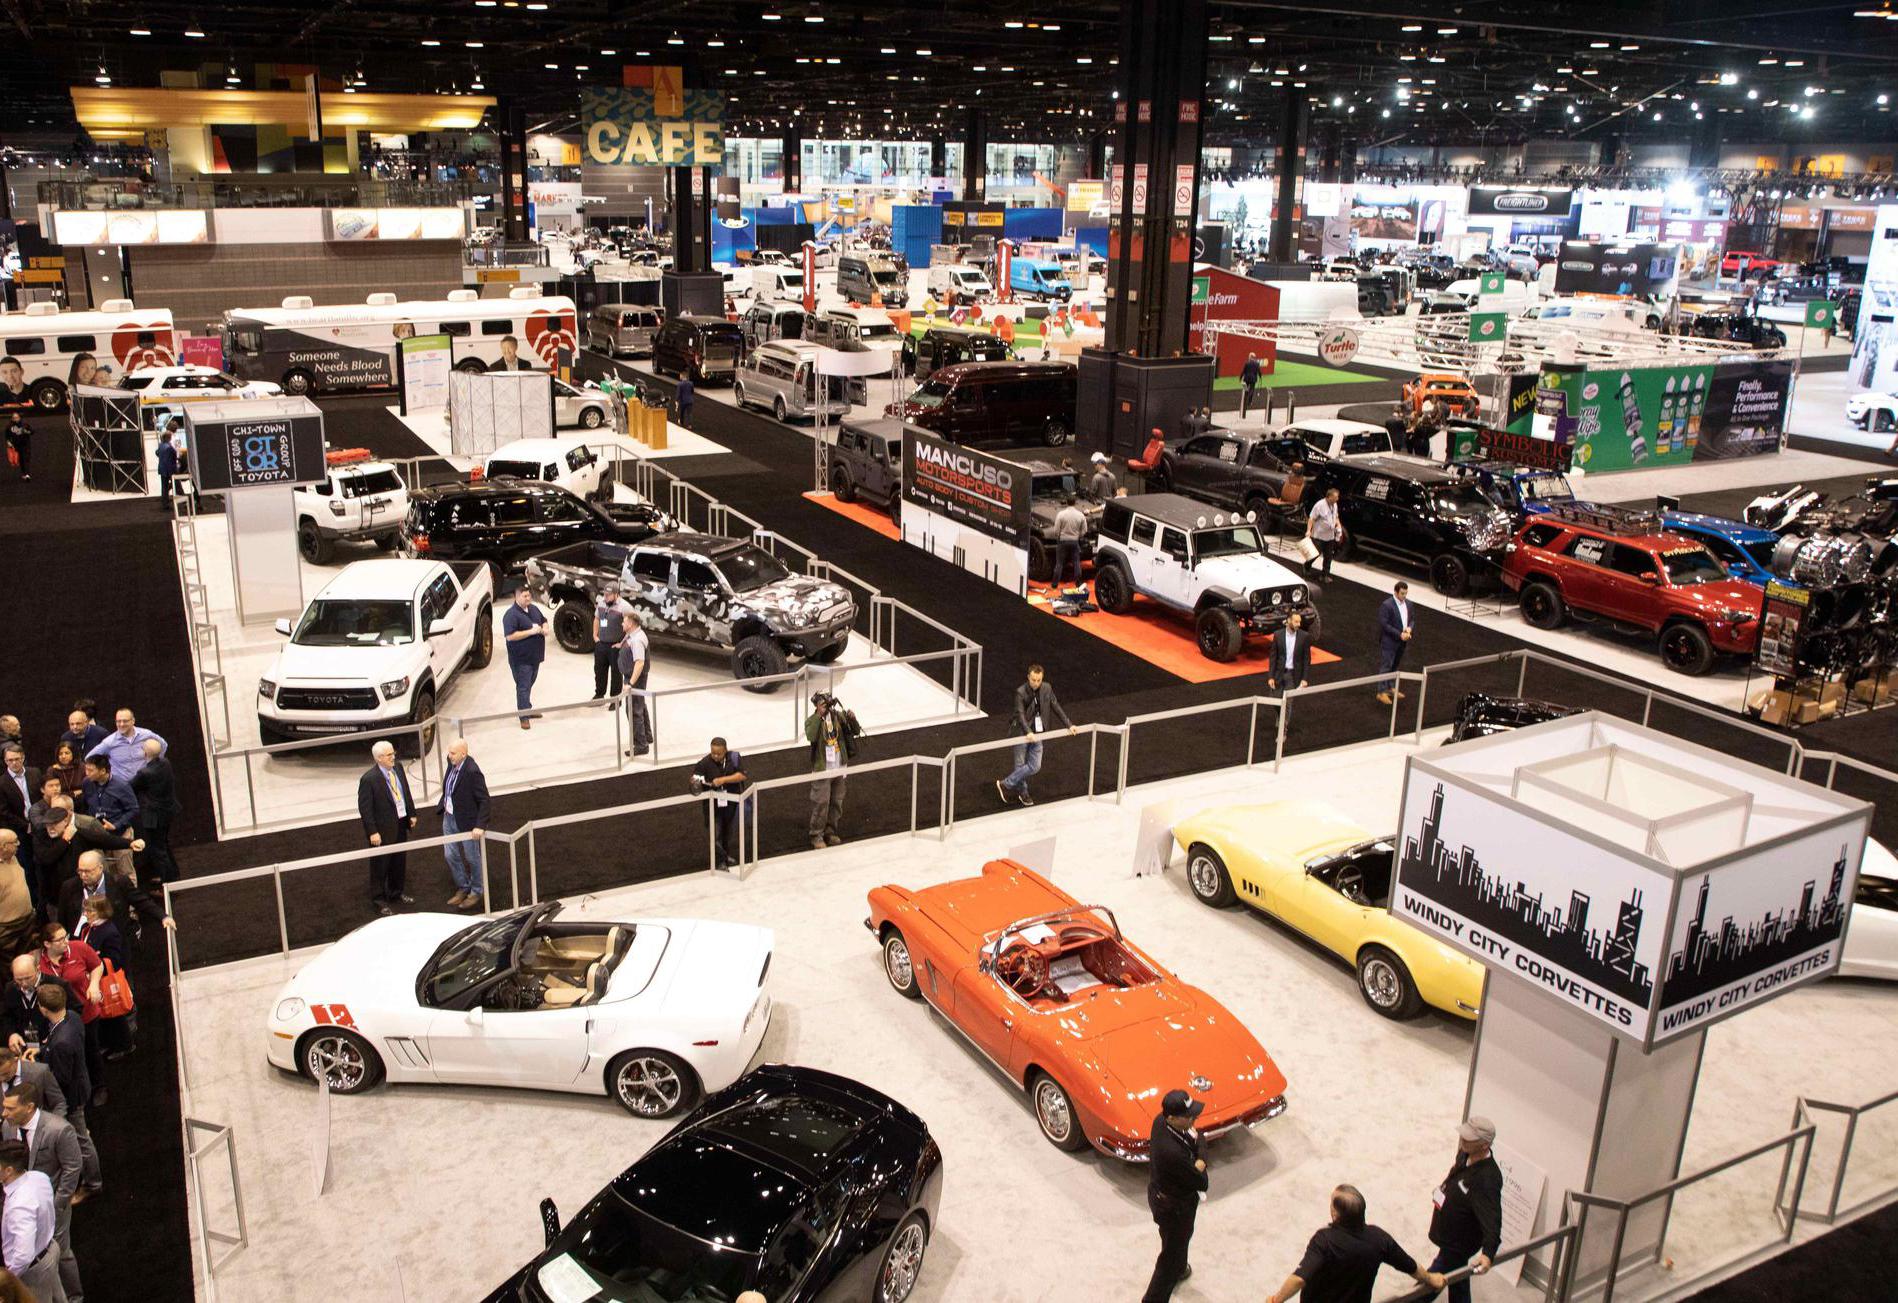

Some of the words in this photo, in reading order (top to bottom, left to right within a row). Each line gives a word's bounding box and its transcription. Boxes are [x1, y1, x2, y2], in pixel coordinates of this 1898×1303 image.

[587, 121, 721, 163] CAFE
[1176, 220, 1188, 228] T24
[1325, 338, 1355, 353] Turtle
[289, 352, 340, 362] Someone
[314, 362, 348, 373] Needs
[351, 359, 383, 371] Blood
[325, 371, 389, 384] Somewhere
[1735, 391, 1779, 402] Performance
[1738, 401, 1779, 413] Convenience
[233, 424, 285, 436] CHI-TOWN
[1480, 428, 1571, 460] SYMBOLIC
[279, 435, 291, 468] GROUP
[916, 441, 1012, 489] MANCUSO
[238, 470, 289, 482] TOYOTA
[916, 459, 1012, 504] MOTORSPORTS
[916, 476, 935, 486] AUTO
[935, 484, 954, 496] BODY
[960, 494, 989, 511] CUSTOM
[307, 696, 344, 704] TOYOTA
[1404, 893, 1466, 937] WINDY
[1469, 930, 1510, 960] CITY
[1515, 954, 1633, 1026] CORVETTES
[1663, 997, 1716, 1031] WINDY
[1719, 983, 1751, 1009] CITY
[1754, 949, 1830, 993] CORVETTES
